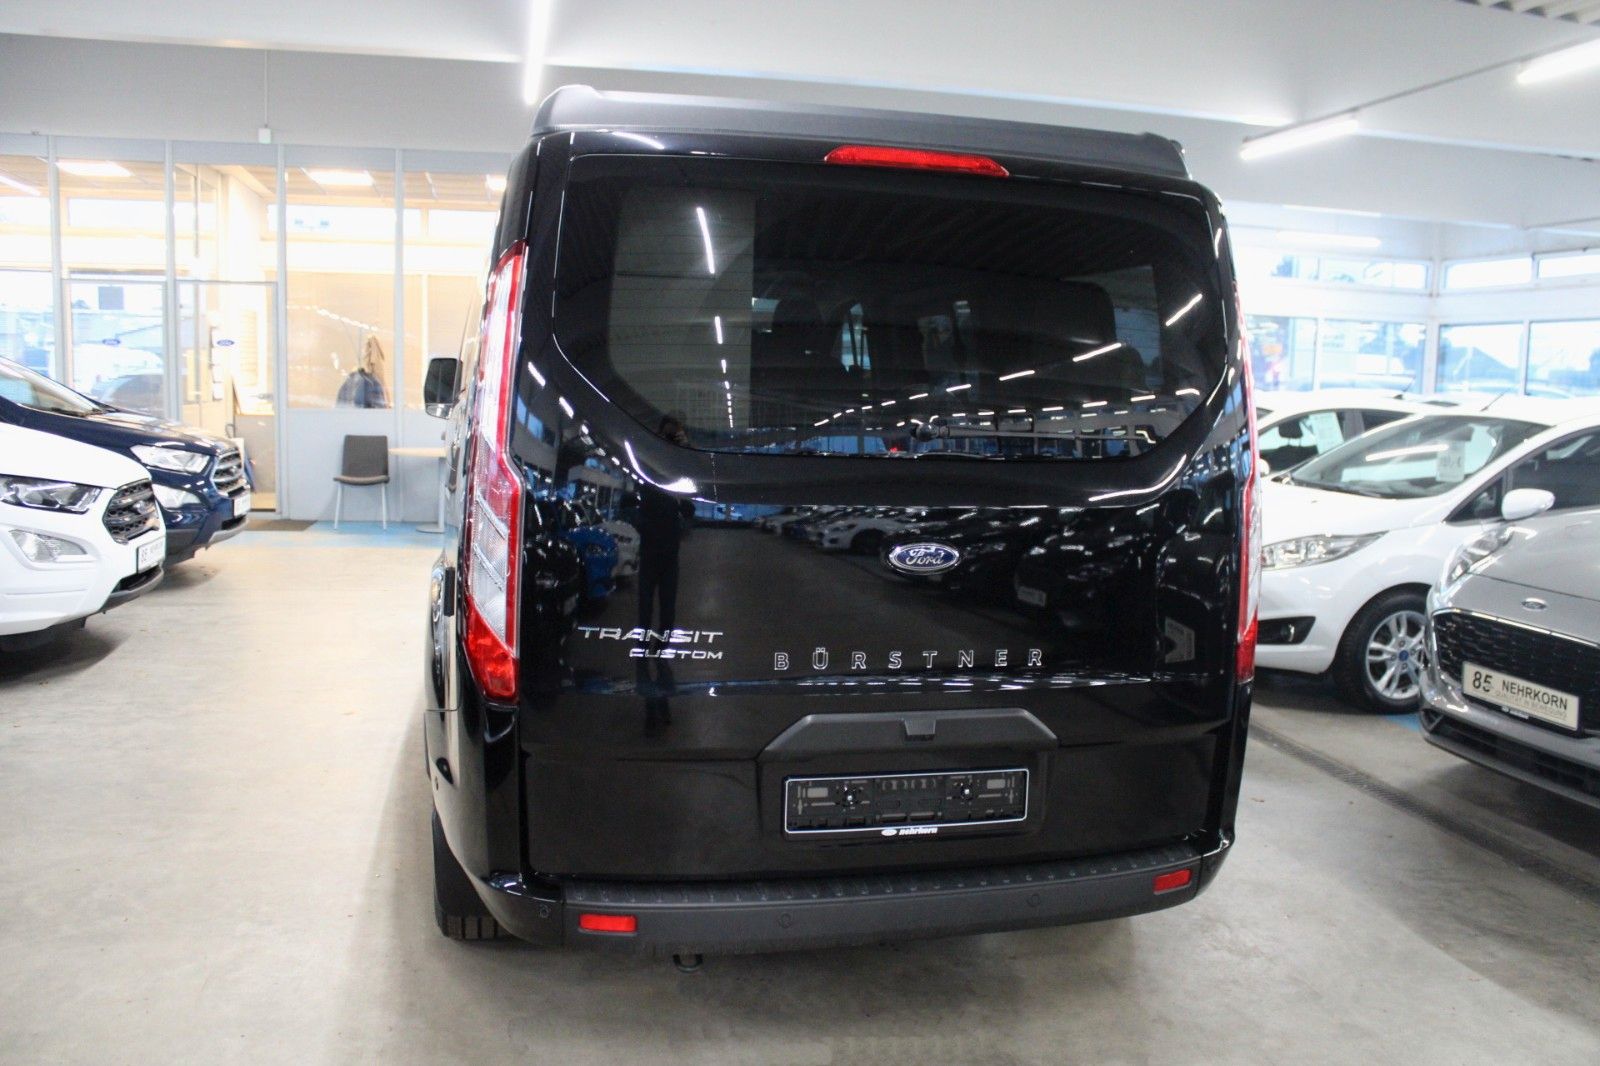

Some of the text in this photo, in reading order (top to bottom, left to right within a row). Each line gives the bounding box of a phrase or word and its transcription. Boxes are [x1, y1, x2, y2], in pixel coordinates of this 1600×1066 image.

[577, 626, 724, 643] TRANSIT
[629, 648, 723, 660] CUSTOM
[774, 647, 1042, 670] BÜRSTNER
[1502, 679, 1568, 711] NEHRKORN
